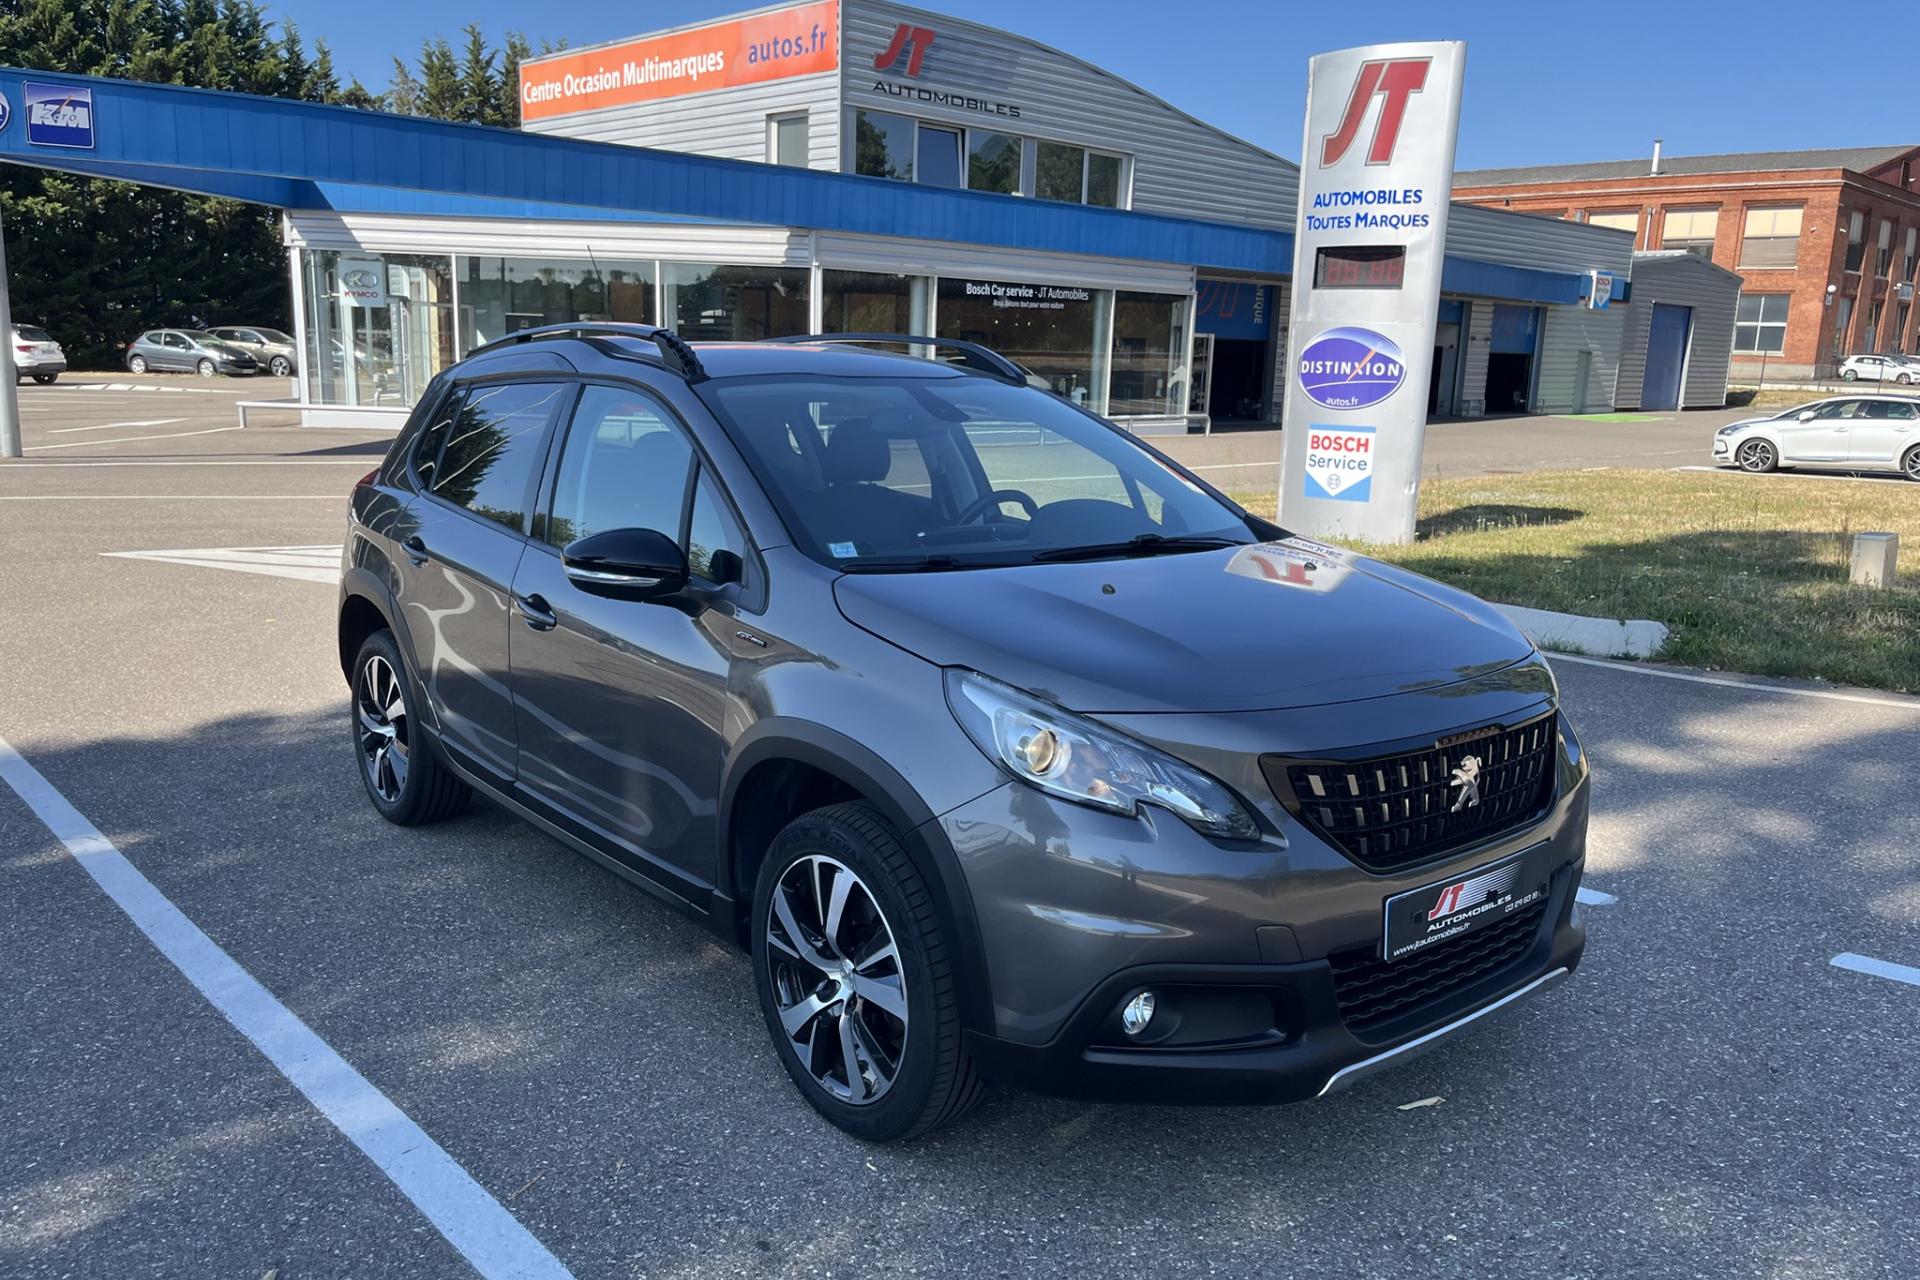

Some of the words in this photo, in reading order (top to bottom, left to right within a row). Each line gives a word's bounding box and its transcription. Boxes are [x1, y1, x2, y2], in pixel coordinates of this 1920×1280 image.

[748, 25, 828, 65] autos.fr
[873, 23, 936, 78] JT
[522, 77, 562, 104] Centre
[563, 62, 621, 97] Occasion
[623, 49, 725, 88] Multimarques
[872, 81, 1021, 118] AUTOMOBILES
[1319, 56, 1433, 169] JT
[1313, 189, 1423, 208] AUTOMOBILES
[966, 283, 990, 295] Bosch
[991, 284, 1005, 296] Car
[1006, 286, 1034, 297] service
[1038, 287, 1047, 298] JT
[1047, 287, 1089, 301] Automobiles
[1301, 359, 1400, 377] DISTINXION
[1325, 396, 1359, 407] autos.fr
[1310, 434, 1370, 453] BOSCH
[1308, 454, 1368, 471] Service
[1426, 894, 1512, 933] AUTOMOBILES
[1427, 882, 1465, 921] JT
